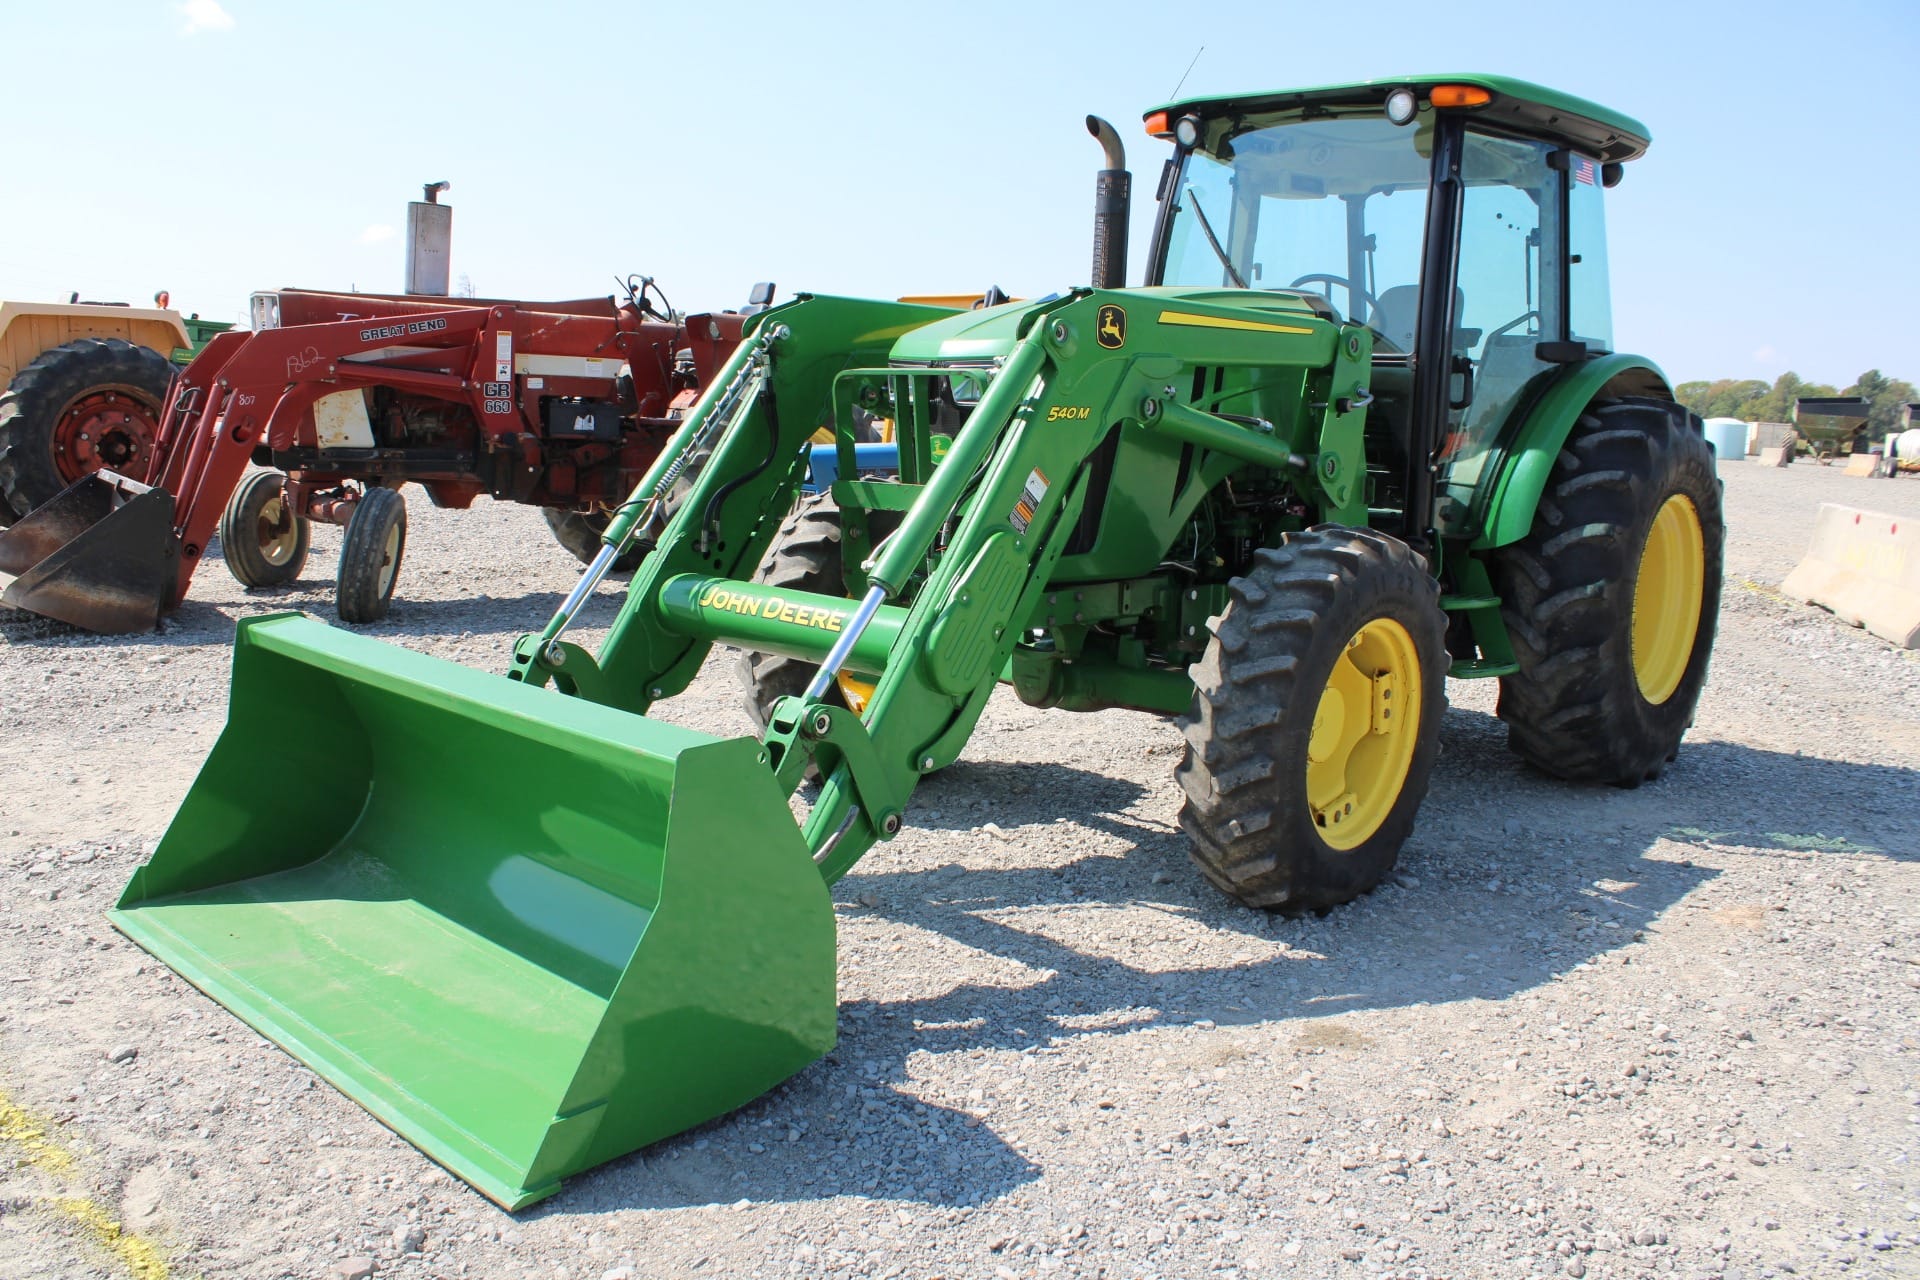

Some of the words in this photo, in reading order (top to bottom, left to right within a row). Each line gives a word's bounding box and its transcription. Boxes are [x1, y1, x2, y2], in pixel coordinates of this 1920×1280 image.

[360, 324, 405, 342] GREAT
[408, 318, 447, 334] BEND
[484, 382, 511, 398] GB
[484, 400, 512, 414] 660
[699, 586, 762, 617] JOHN
[761, 596, 848, 633] DEERE
